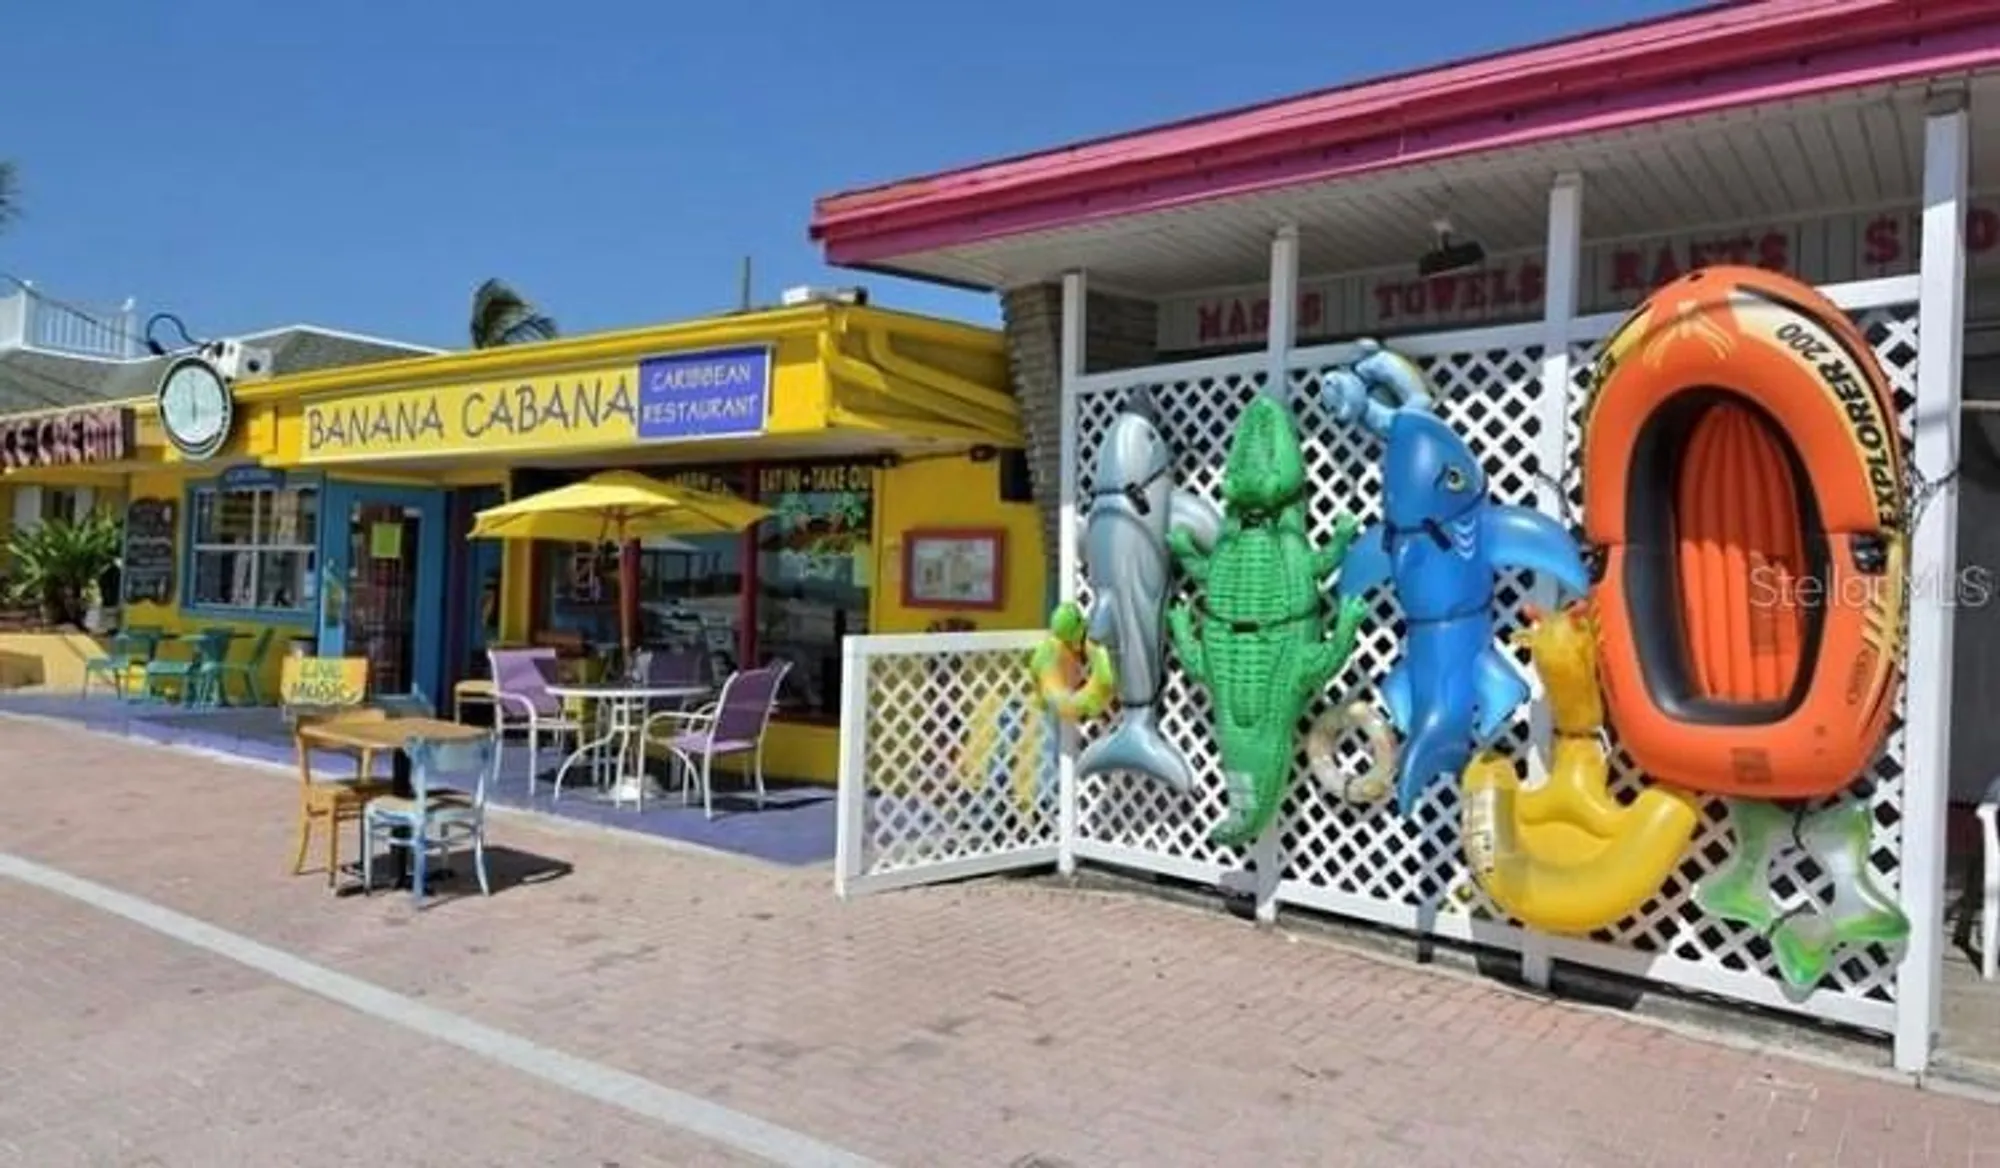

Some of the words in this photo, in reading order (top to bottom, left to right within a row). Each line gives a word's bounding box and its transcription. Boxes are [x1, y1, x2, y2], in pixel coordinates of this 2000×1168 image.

[1197, 286, 1323, 342] MASS
[1374, 261, 1545, 320] TOWELS
[1776, 322, 1830, 362] 200
[651, 363, 751, 393] CARIBBEAN
[306, 396, 445, 450] BANANA
[461, 374, 636, 439] CABANA
[643, 394, 759, 425] RESTAURANT
[1818, 358, 1897, 532] EXPLORER
[811, 466, 846, 490] TAKE
